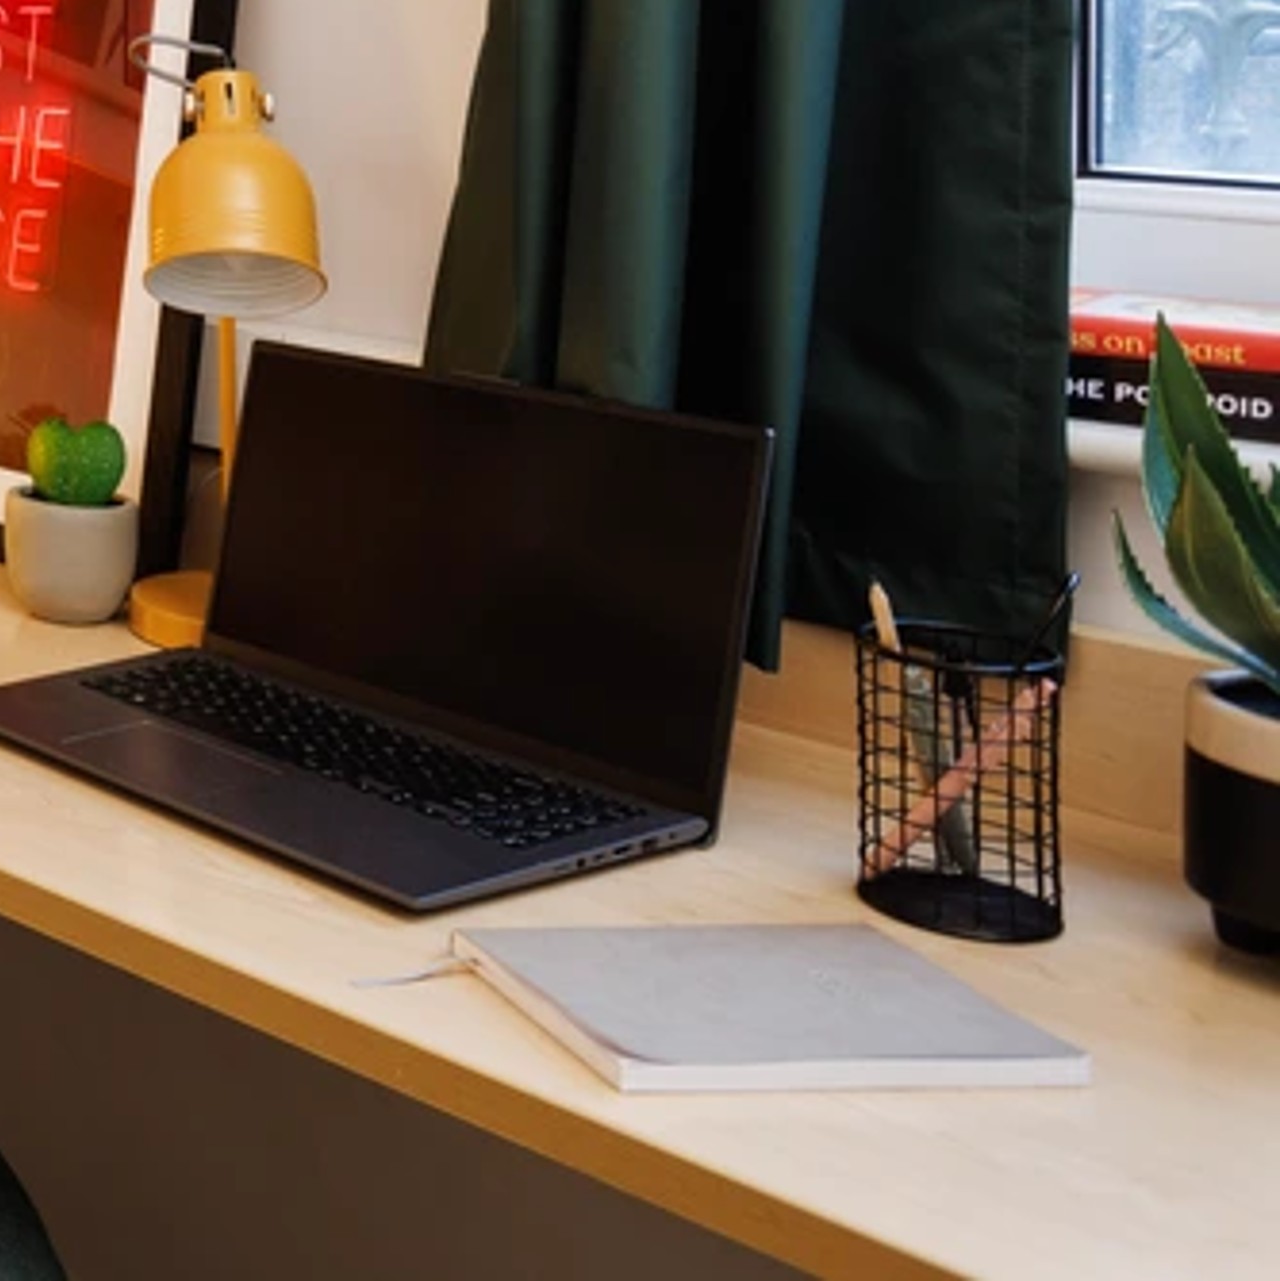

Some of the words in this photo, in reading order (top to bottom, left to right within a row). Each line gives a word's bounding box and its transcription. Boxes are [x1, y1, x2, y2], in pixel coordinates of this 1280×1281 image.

[1102, 332, 1145, 355] on
[1151, 328, 1247, 365] ast
[1065, 377, 1105, 399] HE
[1113, 381, 1273, 419] POOID
